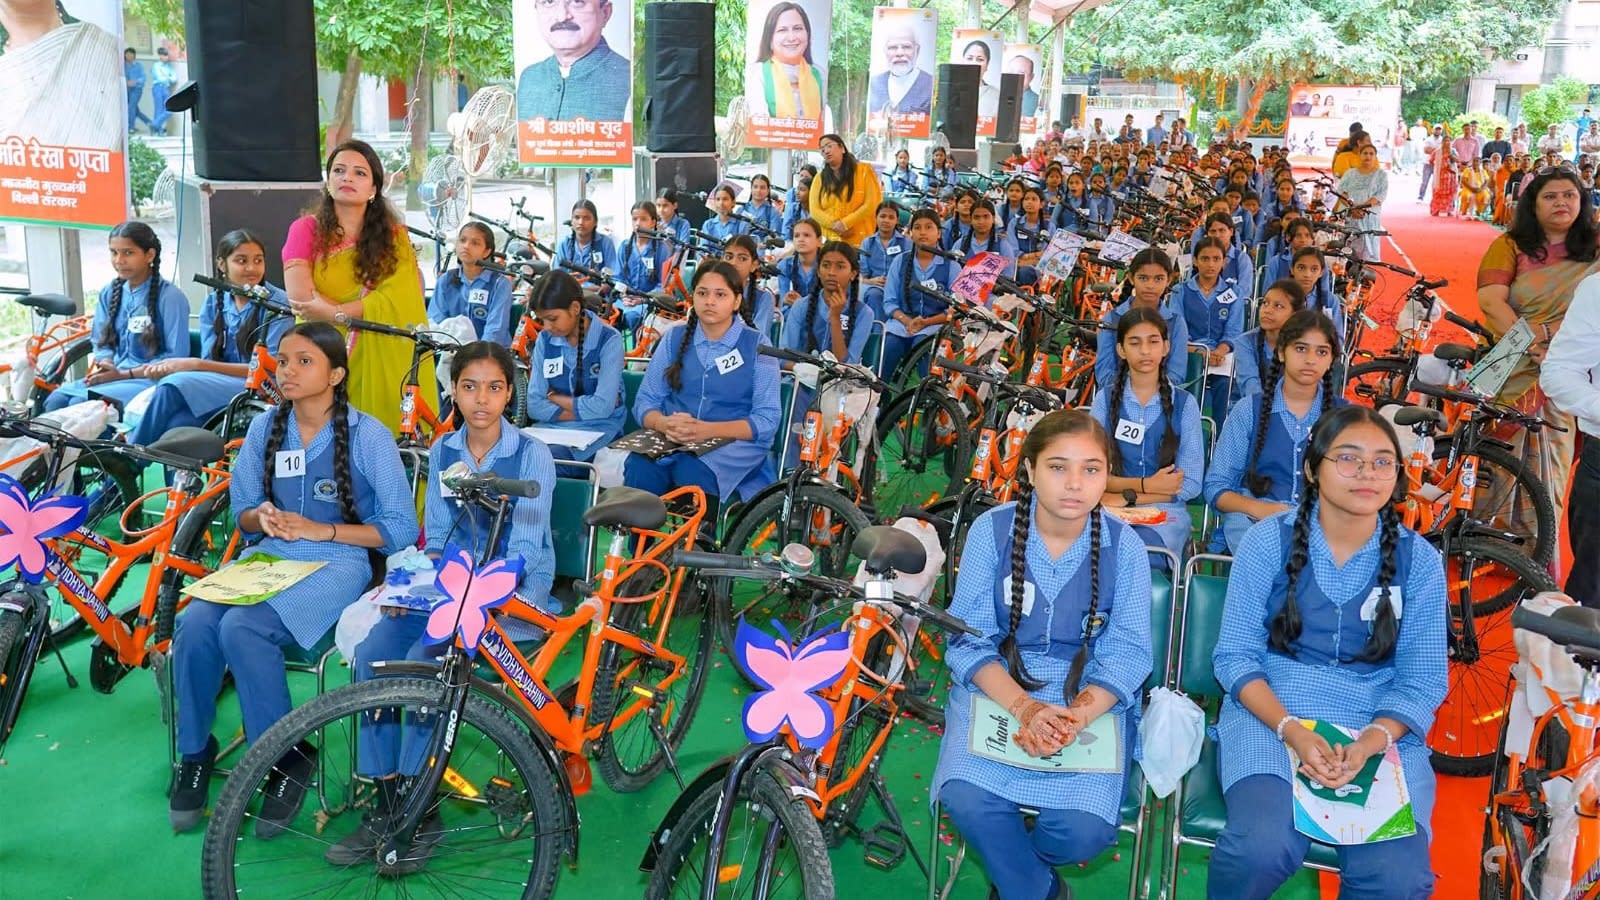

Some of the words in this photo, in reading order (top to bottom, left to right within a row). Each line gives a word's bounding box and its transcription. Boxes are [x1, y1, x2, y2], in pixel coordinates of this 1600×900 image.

[527, 116, 545, 134] श्री
[548, 117, 596, 135] आशीष
[598, 121, 623, 139] सूद
[0, 138, 26, 166] मति
[28, 138, 65, 169] रेखा
[67, 149, 110, 179] गुप्ता
[40, 195, 77, 208] सरकार
[473, 292, 485, 302] 35
[1221, 292, 1233, 303] 44
[548, 361, 561, 376] 21
[721, 355, 740, 370] 22
[1121, 425, 1140, 440] 20
[284, 453, 301, 472] 10
[59, 562, 86, 597] VIDHYA
[86, 591, 109, 622] VAHINI
[498, 644, 525, 684] VIDHYA
[521, 675, 547, 710] VAHINI
[443, 709, 458, 753] HERO
[984, 713, 1009, 754] Thank
